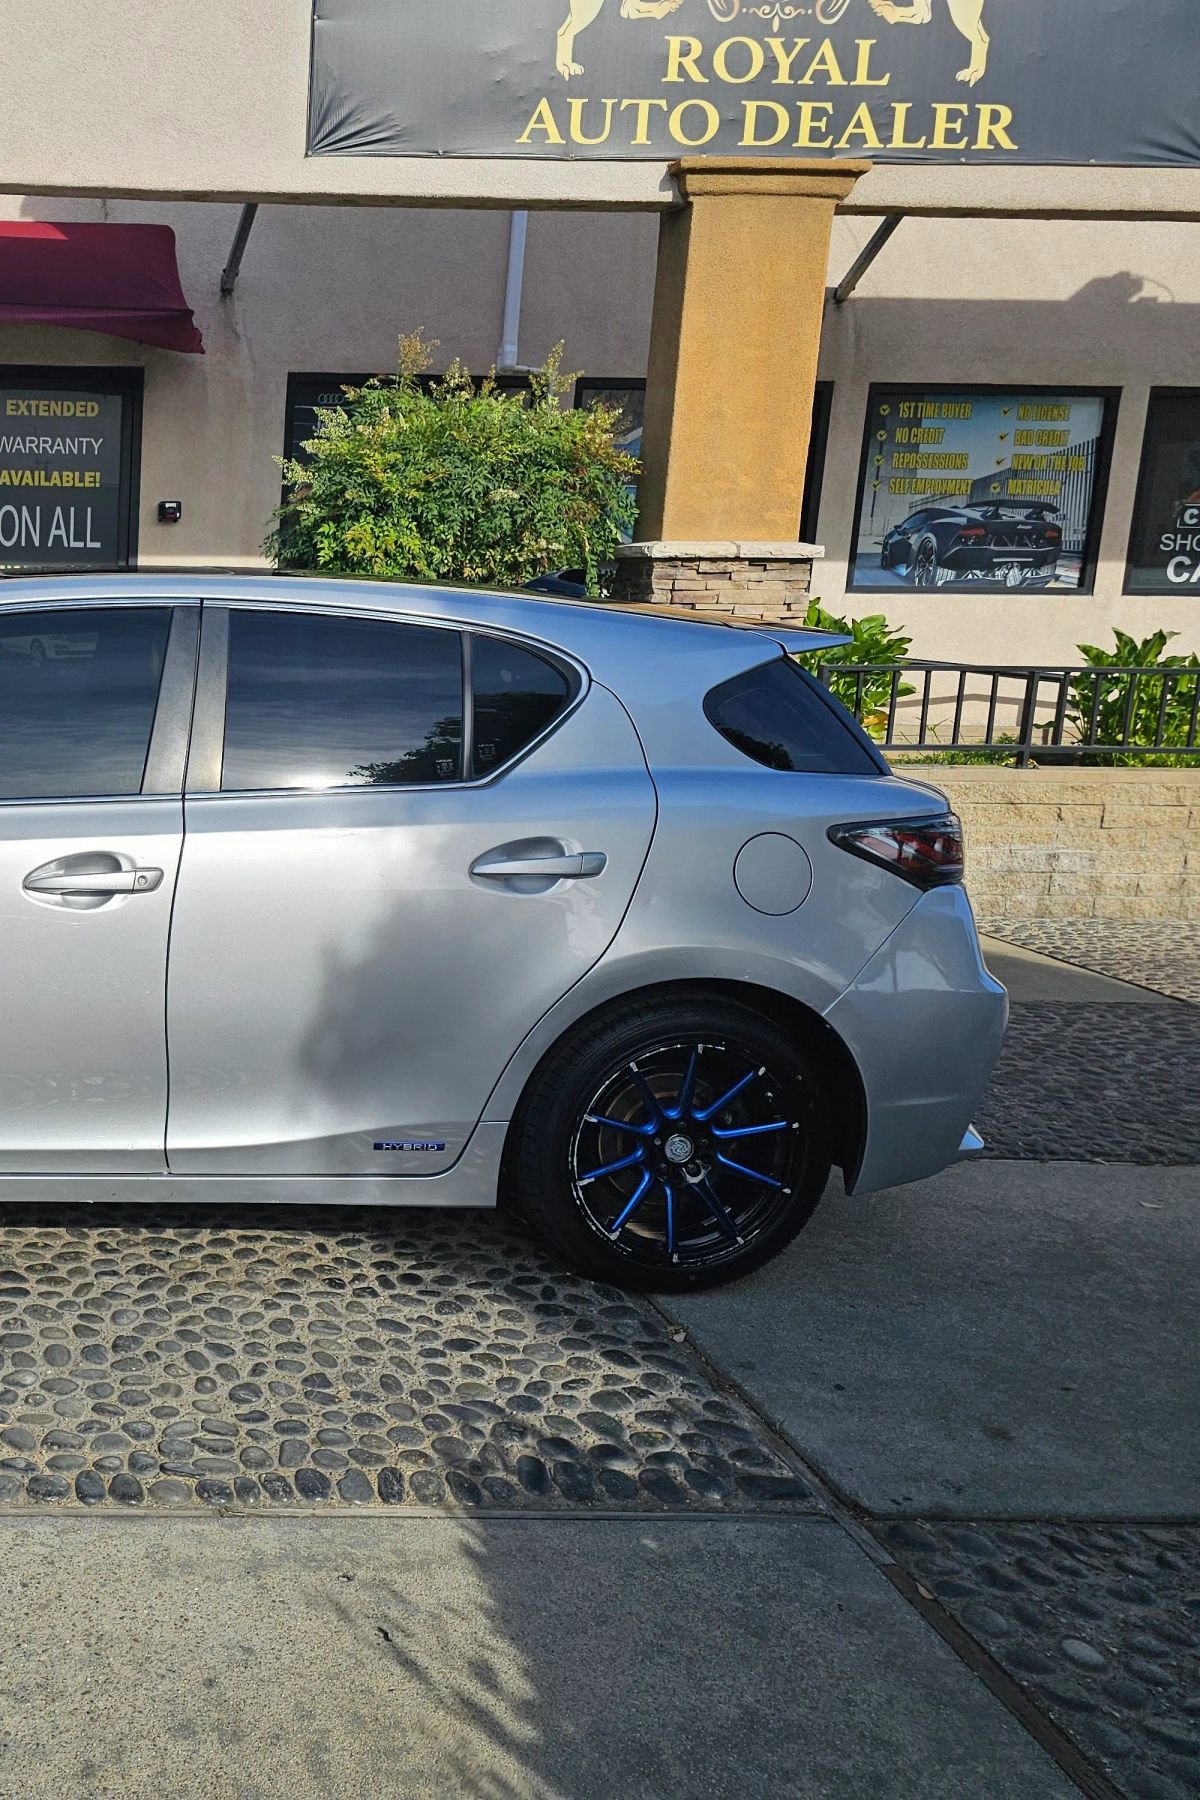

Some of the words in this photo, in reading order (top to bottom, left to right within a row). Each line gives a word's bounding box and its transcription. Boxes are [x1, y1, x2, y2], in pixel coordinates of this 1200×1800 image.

[661, 35, 891, 86] ROYAL
[515, 97, 720, 146] AUTO
[737, 100, 1019, 150] DEALER
[5, 399, 100, 417] EXTENDED
[898, 402, 915, 419] 1ST
[916, 402, 940, 419] TIME
[941, 403, 973, 420] BUYER
[1016, 403, 1032, 421] NO
[895, 427, 910, 444] NO
[910, 428, 945, 444] CREDIT
[1014, 429, 1035, 446] BAD
[1035, 430, 1071, 447] CREDIT
[891, 453, 969, 470] REPOSSESSIONS
[888, 477, 911, 495] SELF
[910, 478, 974, 496] EMPLOYMENT
[1006, 479, 1062, 496] MATRICULA
[47, 506, 102, 548] ALL
[382, 1143, 438, 1151] HYBRID
